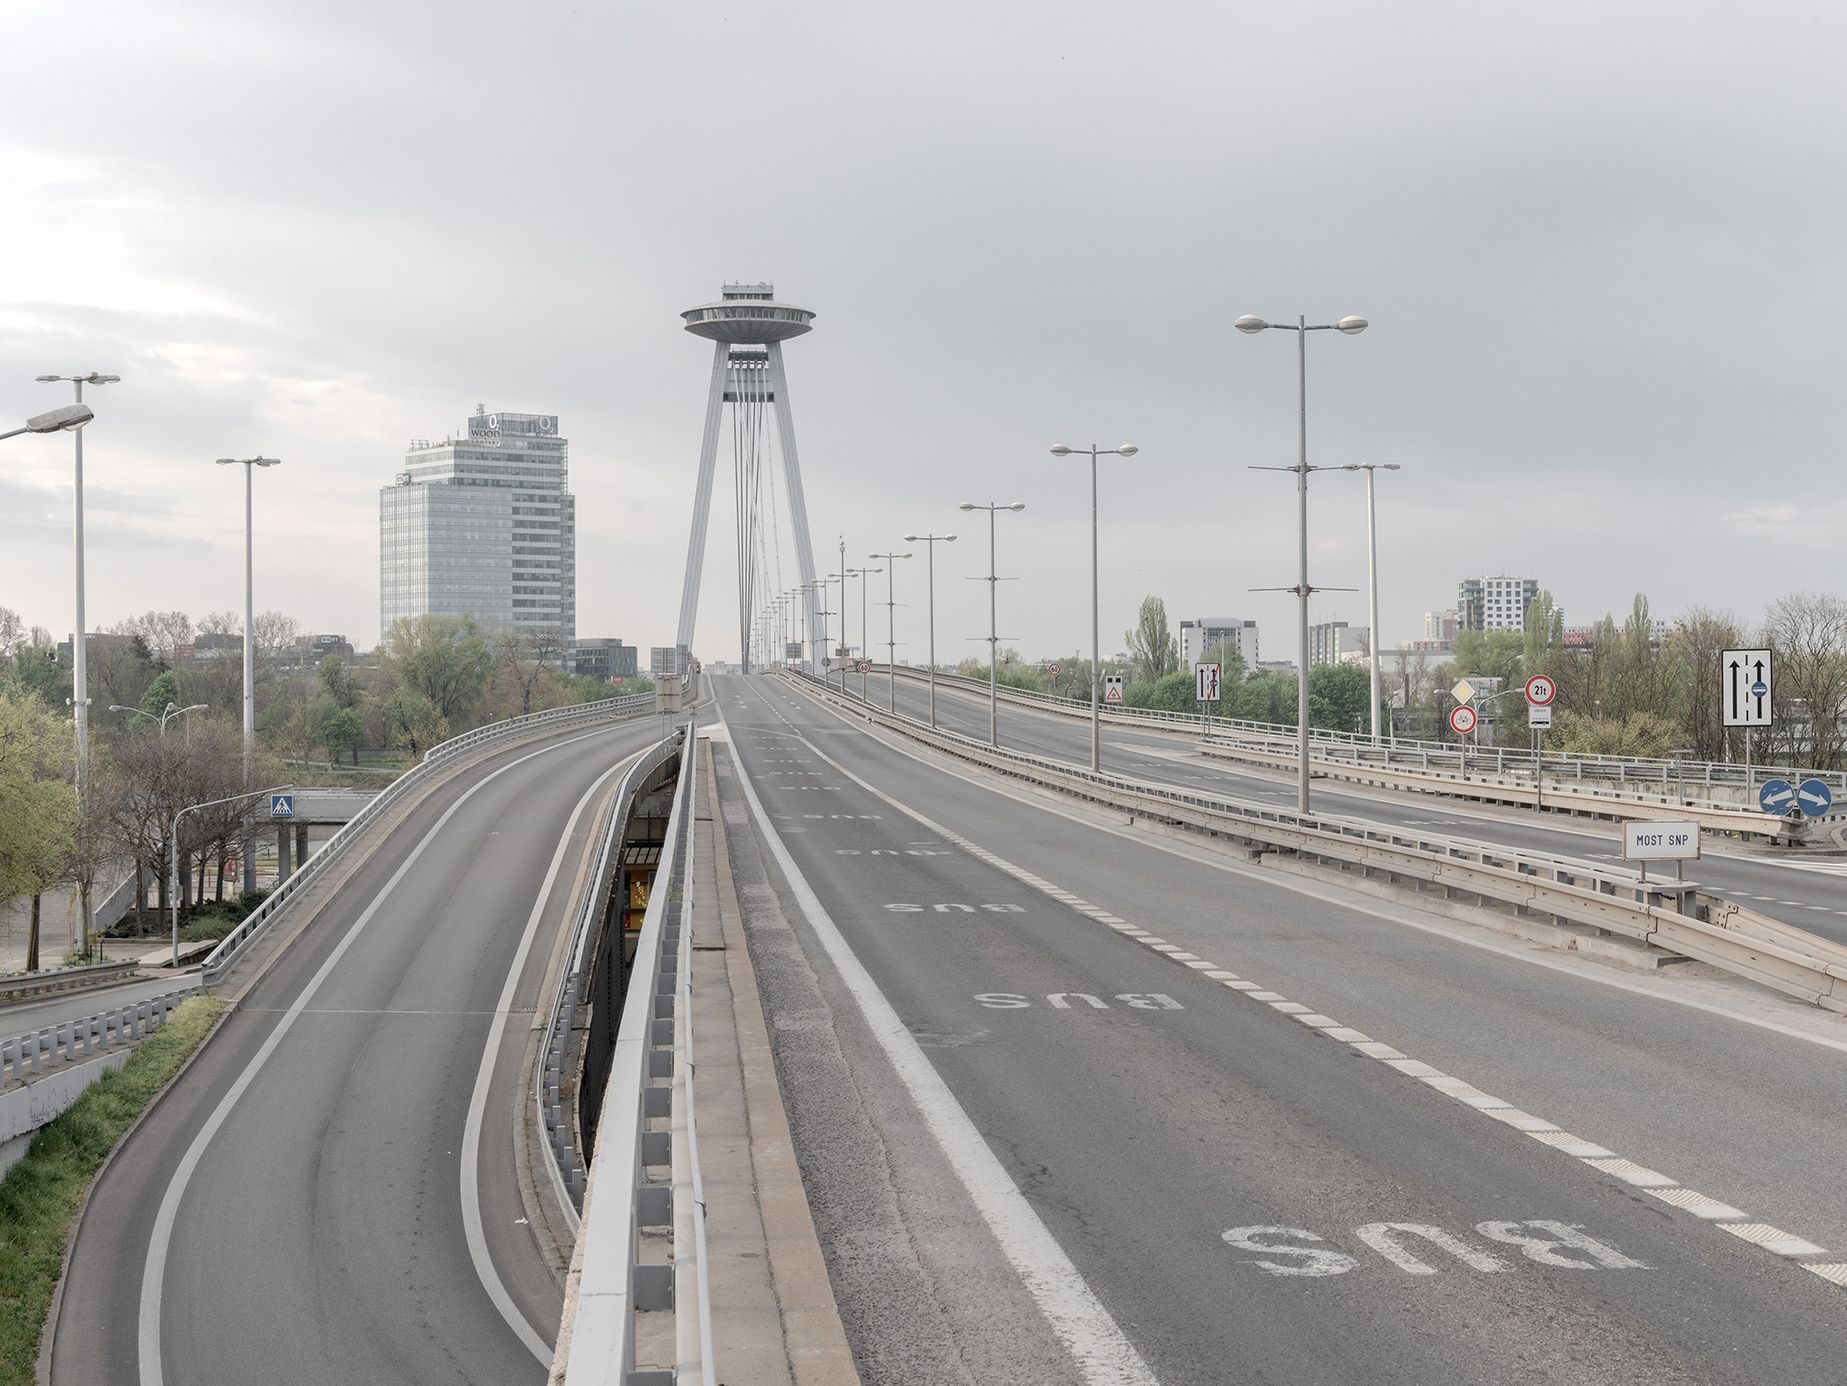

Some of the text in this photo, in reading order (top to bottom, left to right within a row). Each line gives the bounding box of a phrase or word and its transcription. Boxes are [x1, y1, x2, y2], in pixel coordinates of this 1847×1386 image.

[471, 429, 500, 438] WOOD
[1534, 685, 1546, 696] 21t
[1636, 834, 1688, 846] MOST SNP
[884, 903, 1026, 913] BUS
[972, 992, 1185, 1010] BUS
[1221, 1219, 1658, 1277] BUS
